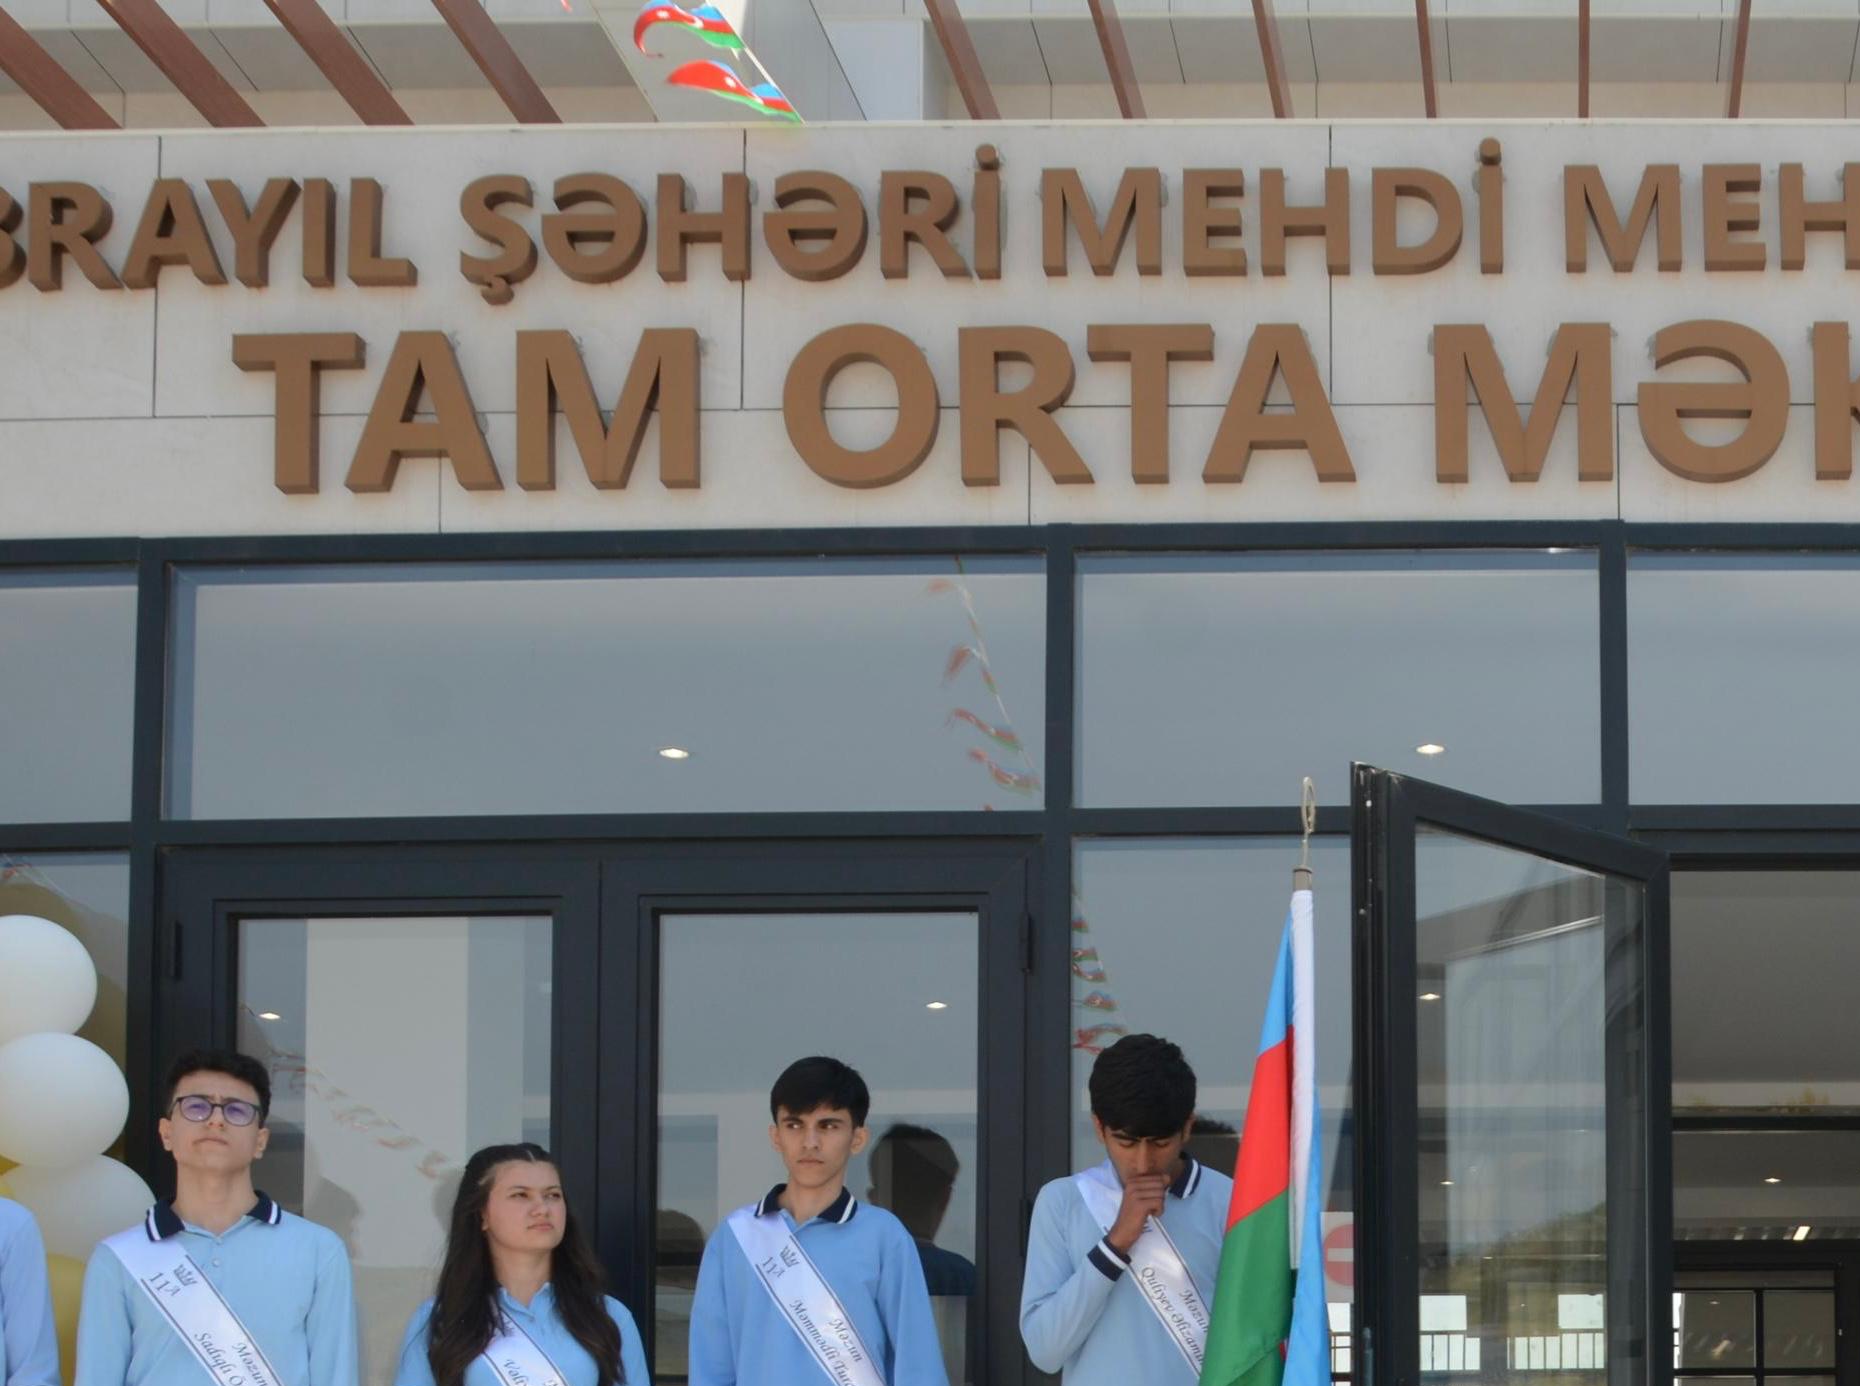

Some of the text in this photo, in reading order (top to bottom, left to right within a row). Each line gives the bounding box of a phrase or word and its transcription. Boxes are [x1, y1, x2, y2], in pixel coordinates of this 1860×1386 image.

[458, 143, 1003, 306] ŞƏHƏRİ
[1039, 137, 1505, 277] MEHDİ
[232, 326, 702, 495] TAM
[782, 322, 1357, 489] ORTA
[828, 1317, 863, 1364] Məzun
